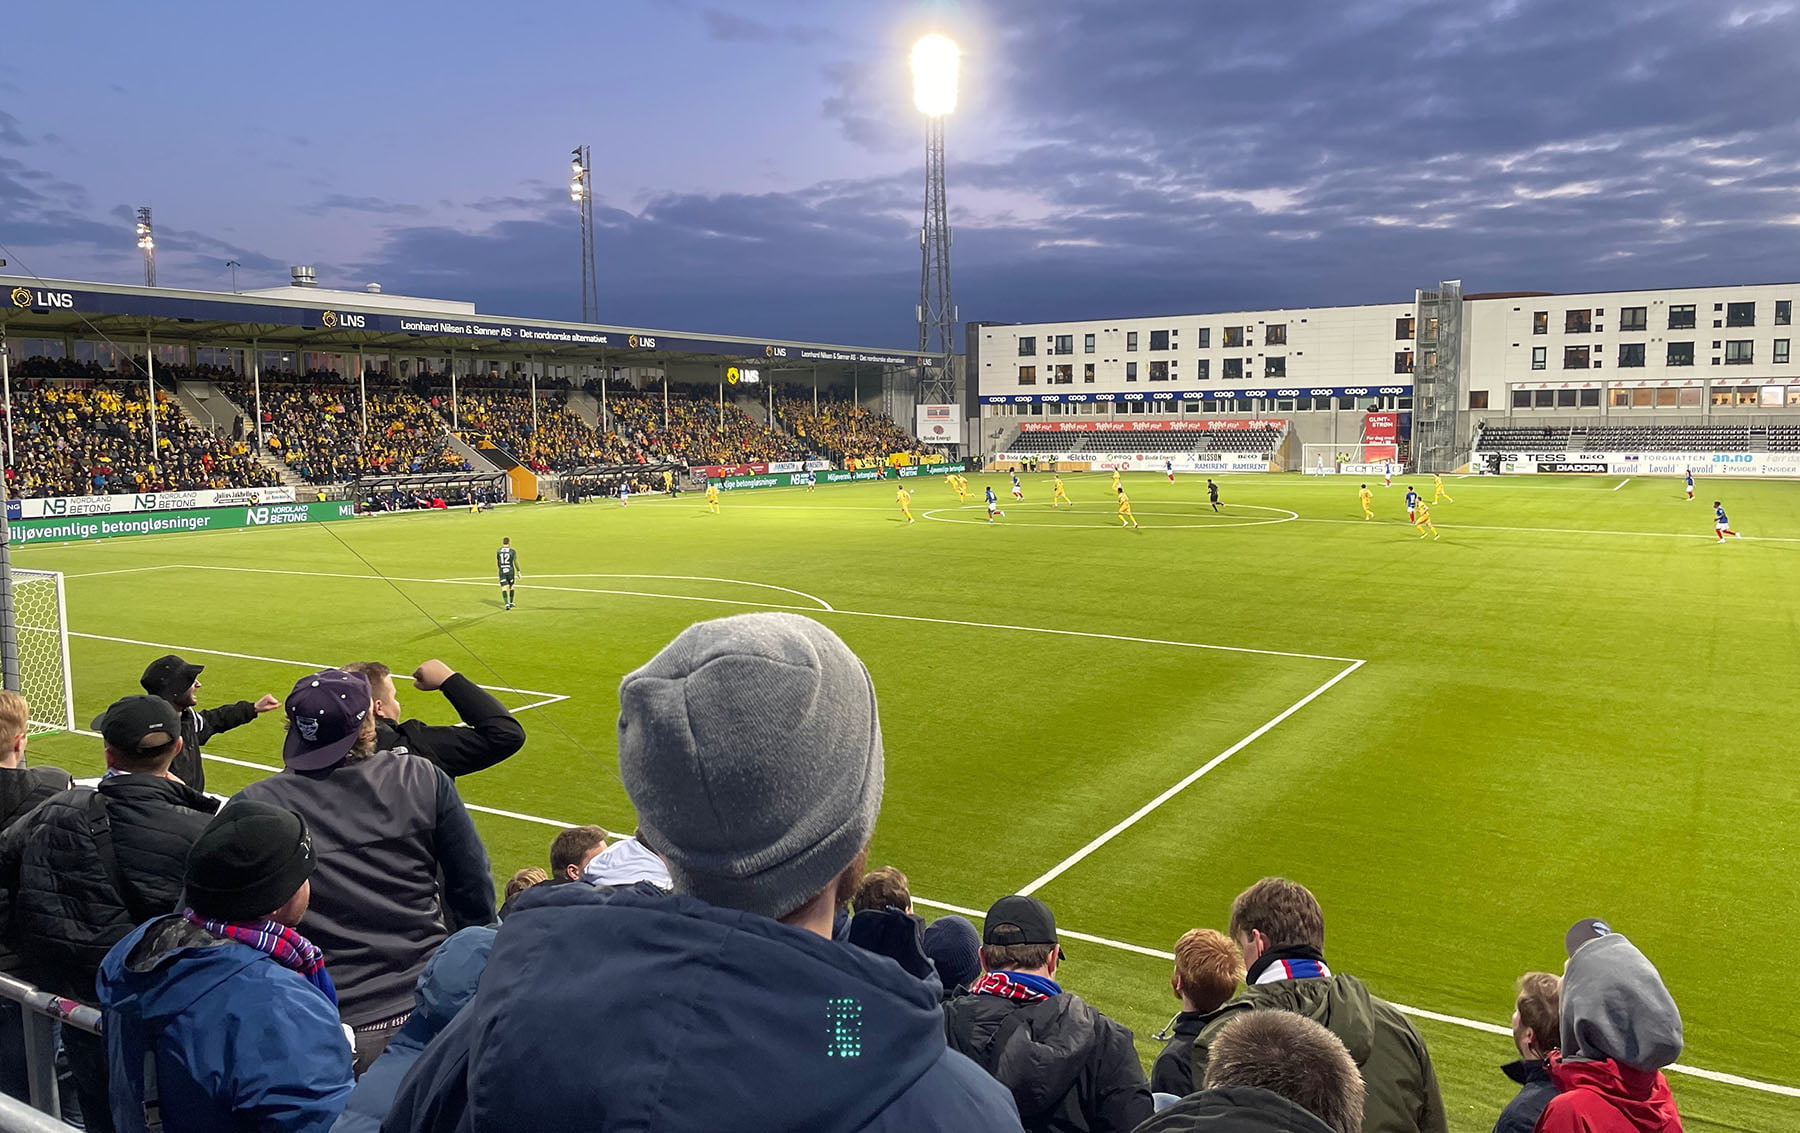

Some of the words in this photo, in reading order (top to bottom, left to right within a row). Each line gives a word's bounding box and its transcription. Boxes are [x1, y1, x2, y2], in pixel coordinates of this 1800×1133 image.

[37, 292, 73, 308] LNS
[340, 314, 365, 328] LNS
[401, 320, 438, 332] Leonhard
[440, 323, 464, 334] Nilsen
[466, 325, 472, 334] &
[501, 328, 512, 337] AS
[520, 329, 533, 338] Det
[534, 332, 570, 340] nordnorske
[639, 338, 656, 347] LNS
[774, 348, 786, 357] LNS
[923, 358, 932, 366] LNS
[740, 369, 759, 383] LNS
[1278, 389, 1299, 397] coop
[1311, 388, 1333, 396] coop
[1345, 387, 1368, 396] coop
[1379, 387, 1403, 395] coop
[1712, 454, 1753, 462] an.no
[1556, 464, 1605, 472] DIADORA
[43, 499, 67, 515] NB
[69, 496, 112, 504] NORDLAND
[135, 494, 156, 509] NB
[158, 499, 196, 508] BETONG
[69, 503, 111, 514] BETONG
[246, 508, 268, 525] NB
[271, 505, 309, 514] NORDLAND
[270, 512, 308, 524] BETONG
[101, 516, 210, 534] betongløsninger
[500, 553, 510, 564] 12
